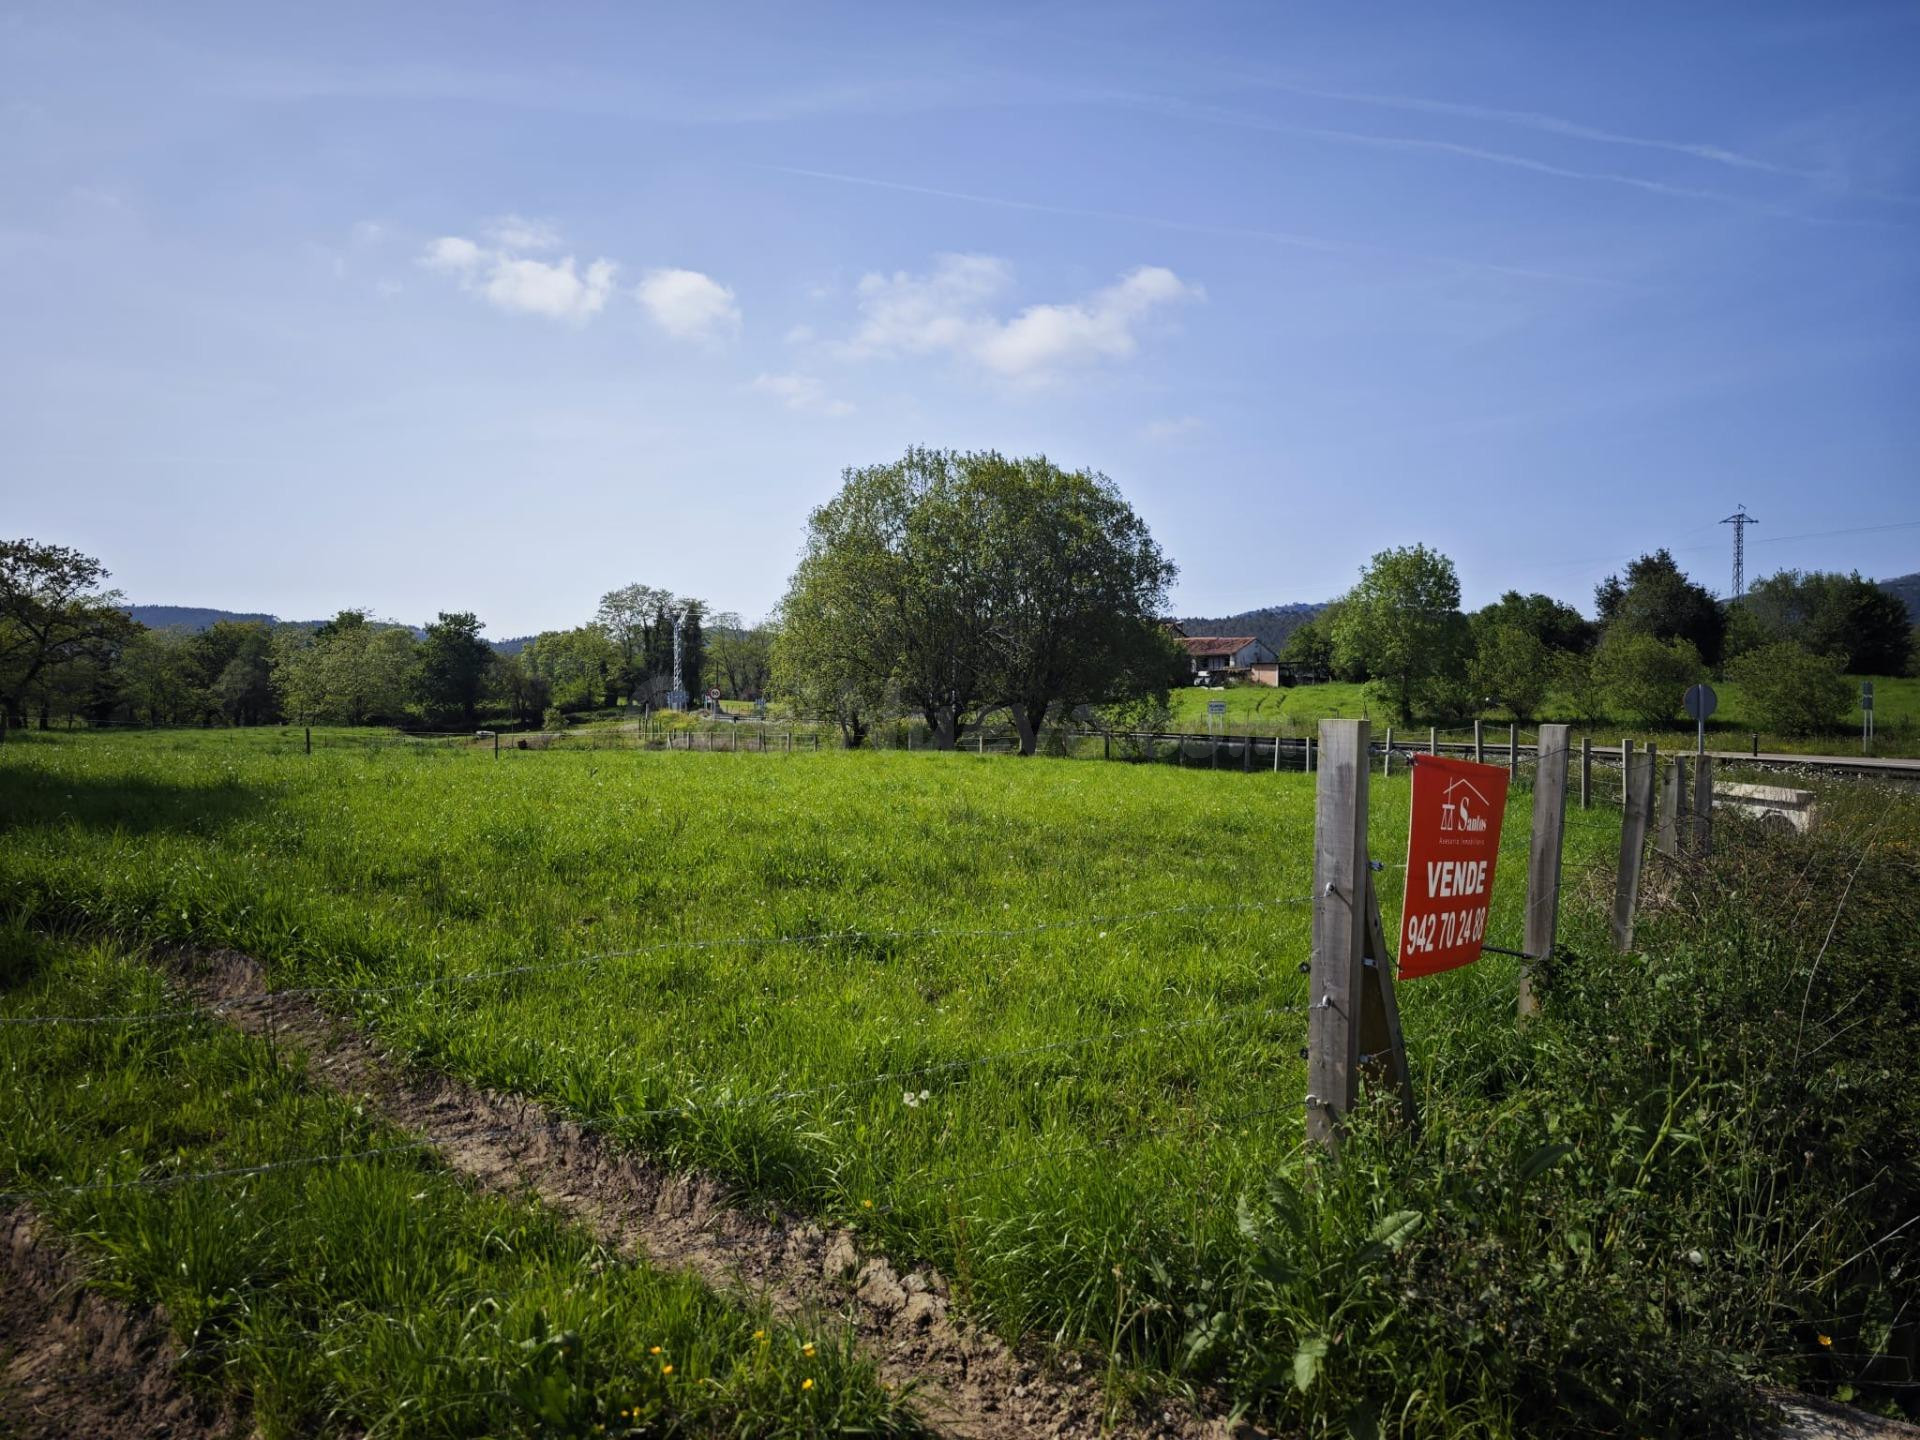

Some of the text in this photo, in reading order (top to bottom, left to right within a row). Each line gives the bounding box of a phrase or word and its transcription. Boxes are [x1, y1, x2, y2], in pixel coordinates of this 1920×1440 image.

[1458, 796, 1487, 831] Santos
[1427, 861, 1488, 898] VENDE
[1407, 906, 1486, 955] 942 70 24 88
